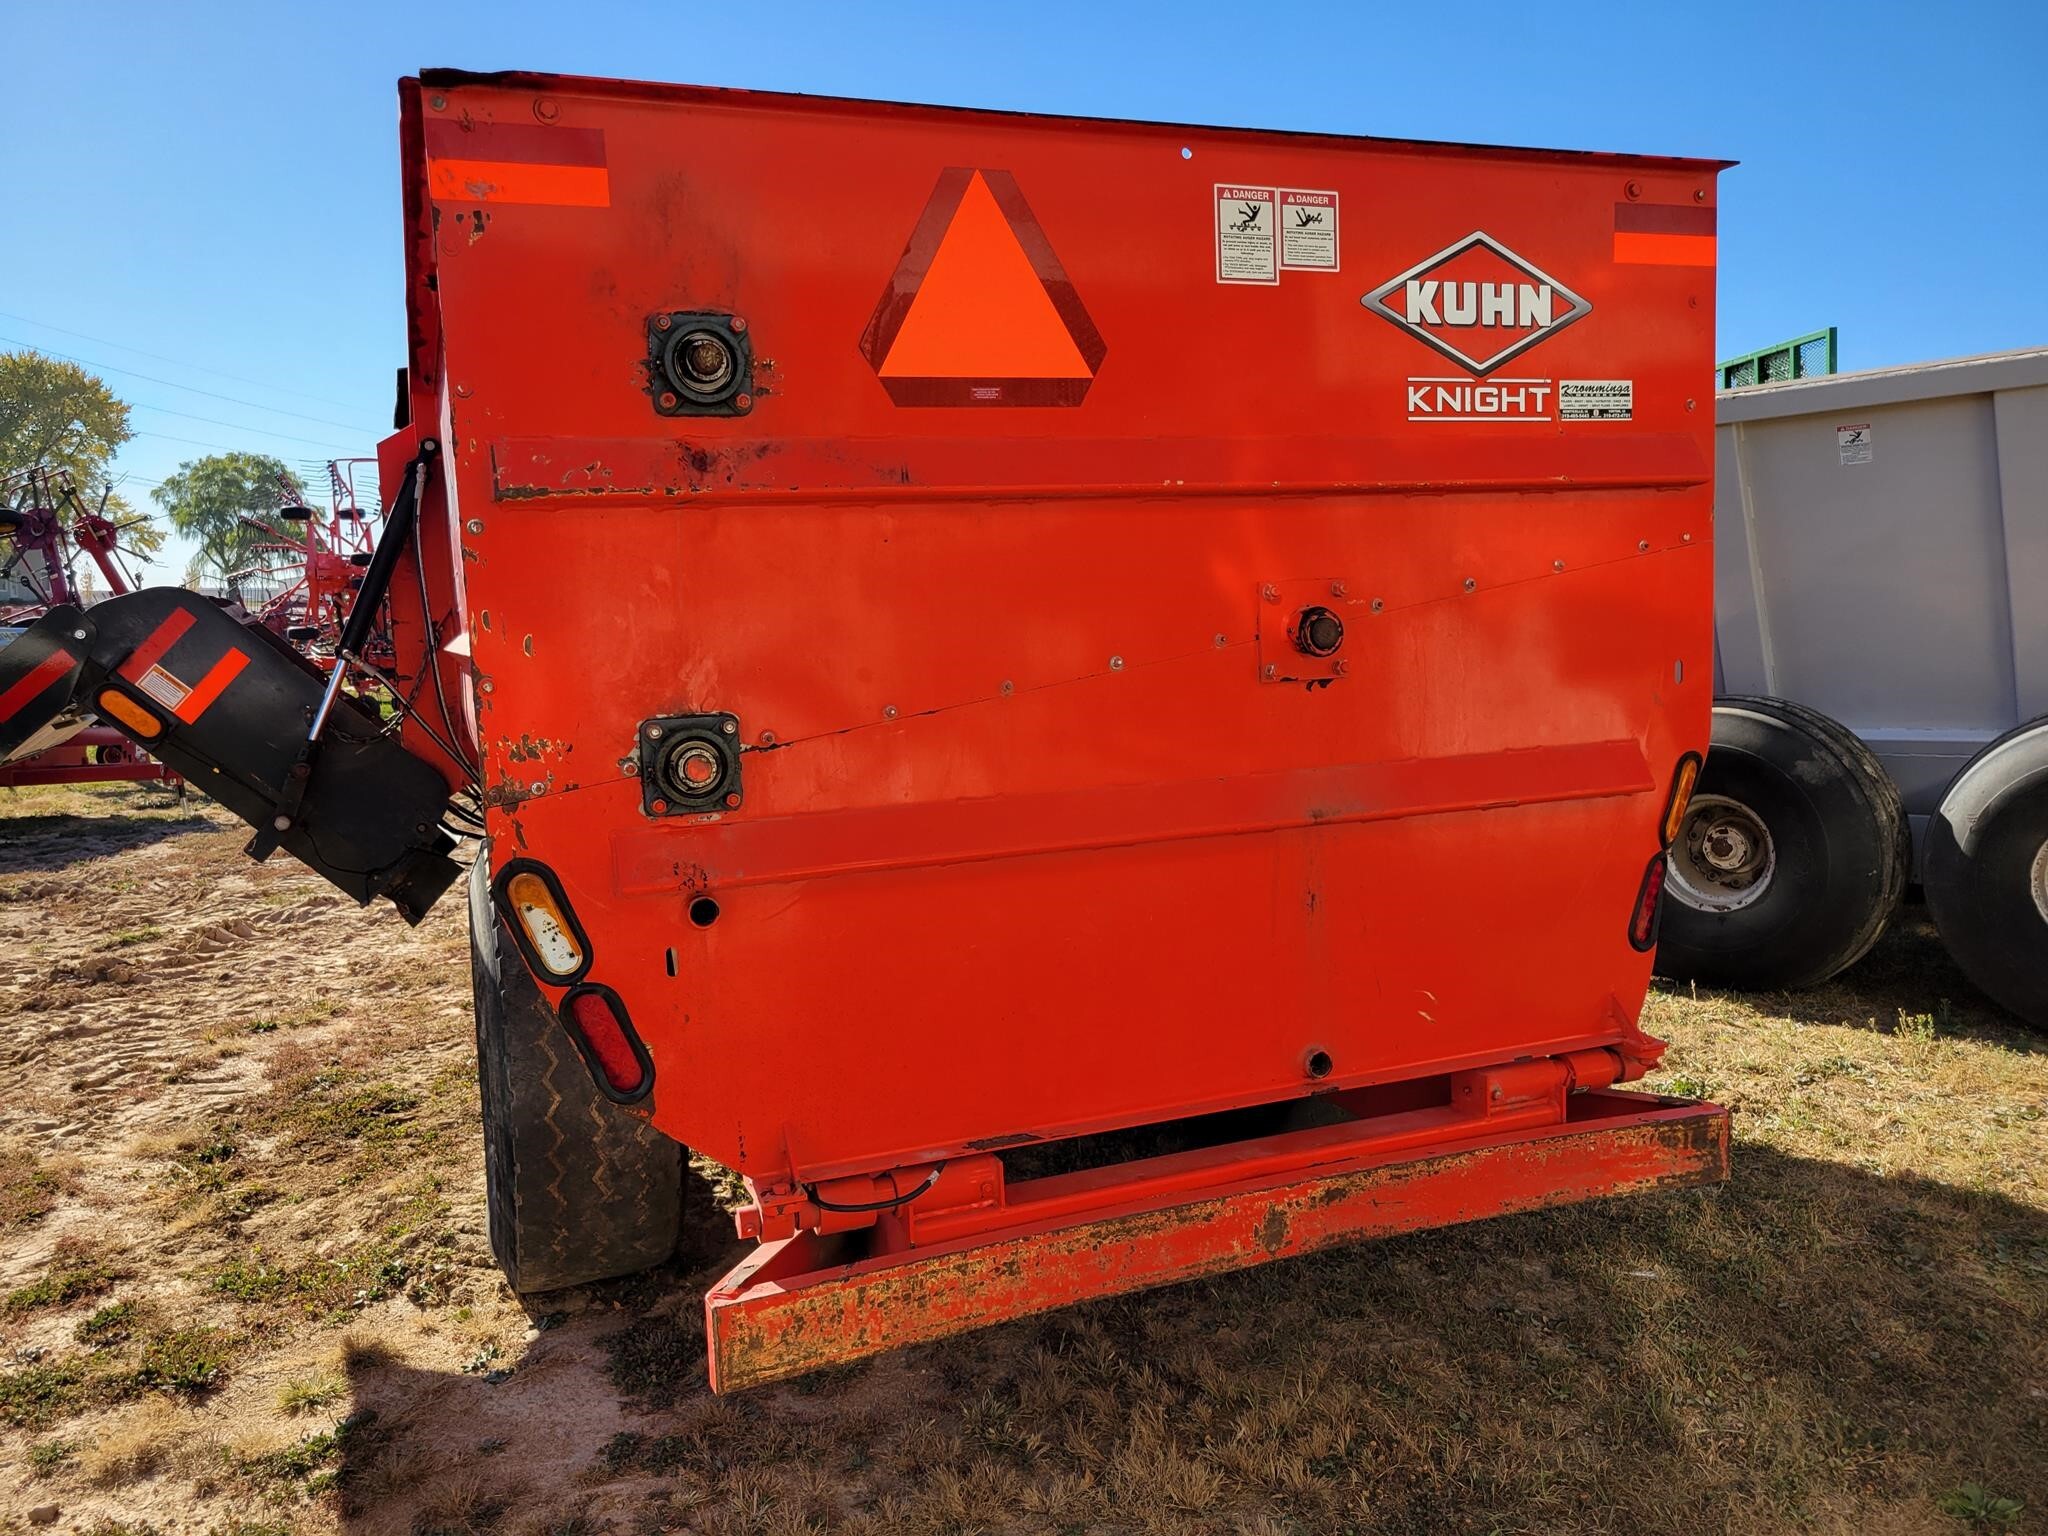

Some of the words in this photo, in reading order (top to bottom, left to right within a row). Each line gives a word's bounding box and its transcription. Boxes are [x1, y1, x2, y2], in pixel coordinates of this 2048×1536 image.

[1233, 190, 1270, 200] DANGER
[1296, 195, 1329, 205] DANGER
[1406, 280, 1552, 327] KUHN
[1561, 383, 1631, 397] Kromminga
[1407, 386, 1551, 413] KNIGHT
